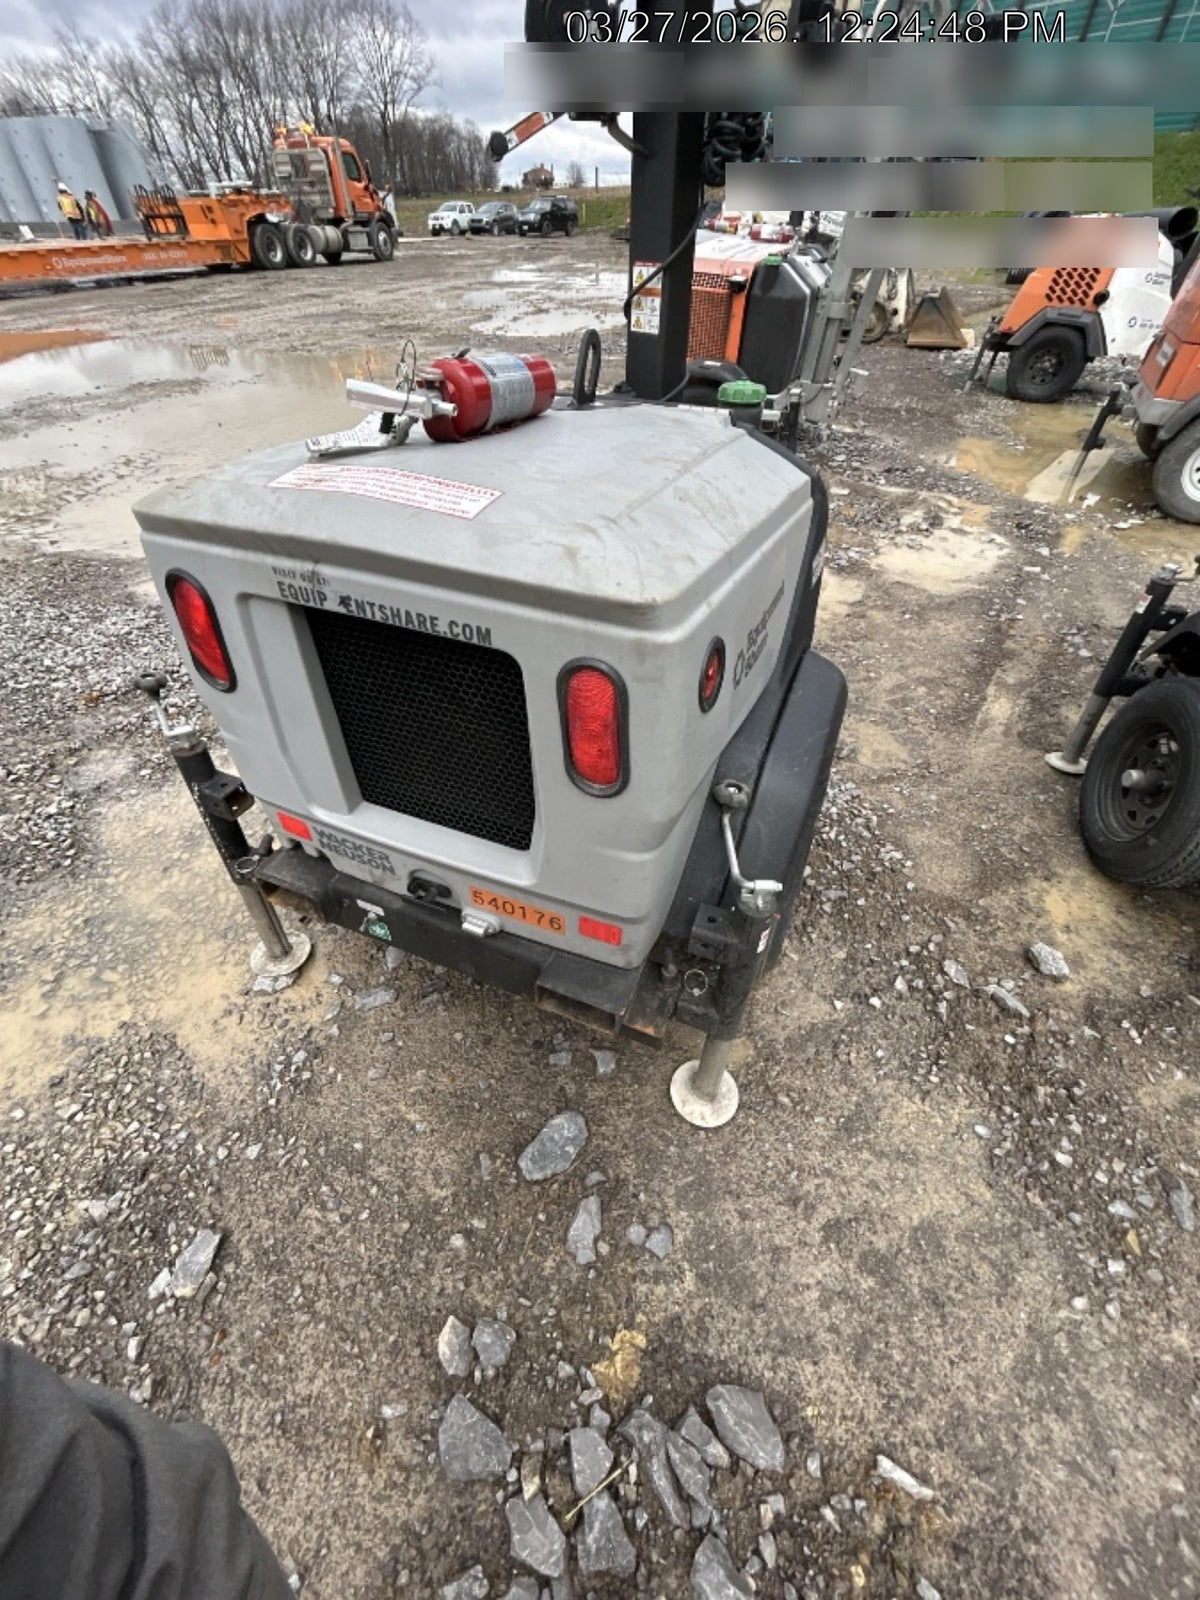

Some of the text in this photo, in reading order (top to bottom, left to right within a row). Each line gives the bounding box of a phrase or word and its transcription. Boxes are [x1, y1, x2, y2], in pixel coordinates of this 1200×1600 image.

[276, 581, 493, 646] EQUIPENTSHARE.COM
[312, 826, 392, 866] WACKER
[318, 839, 397, 876] NEUSON
[472, 889, 563, 931] 540176
